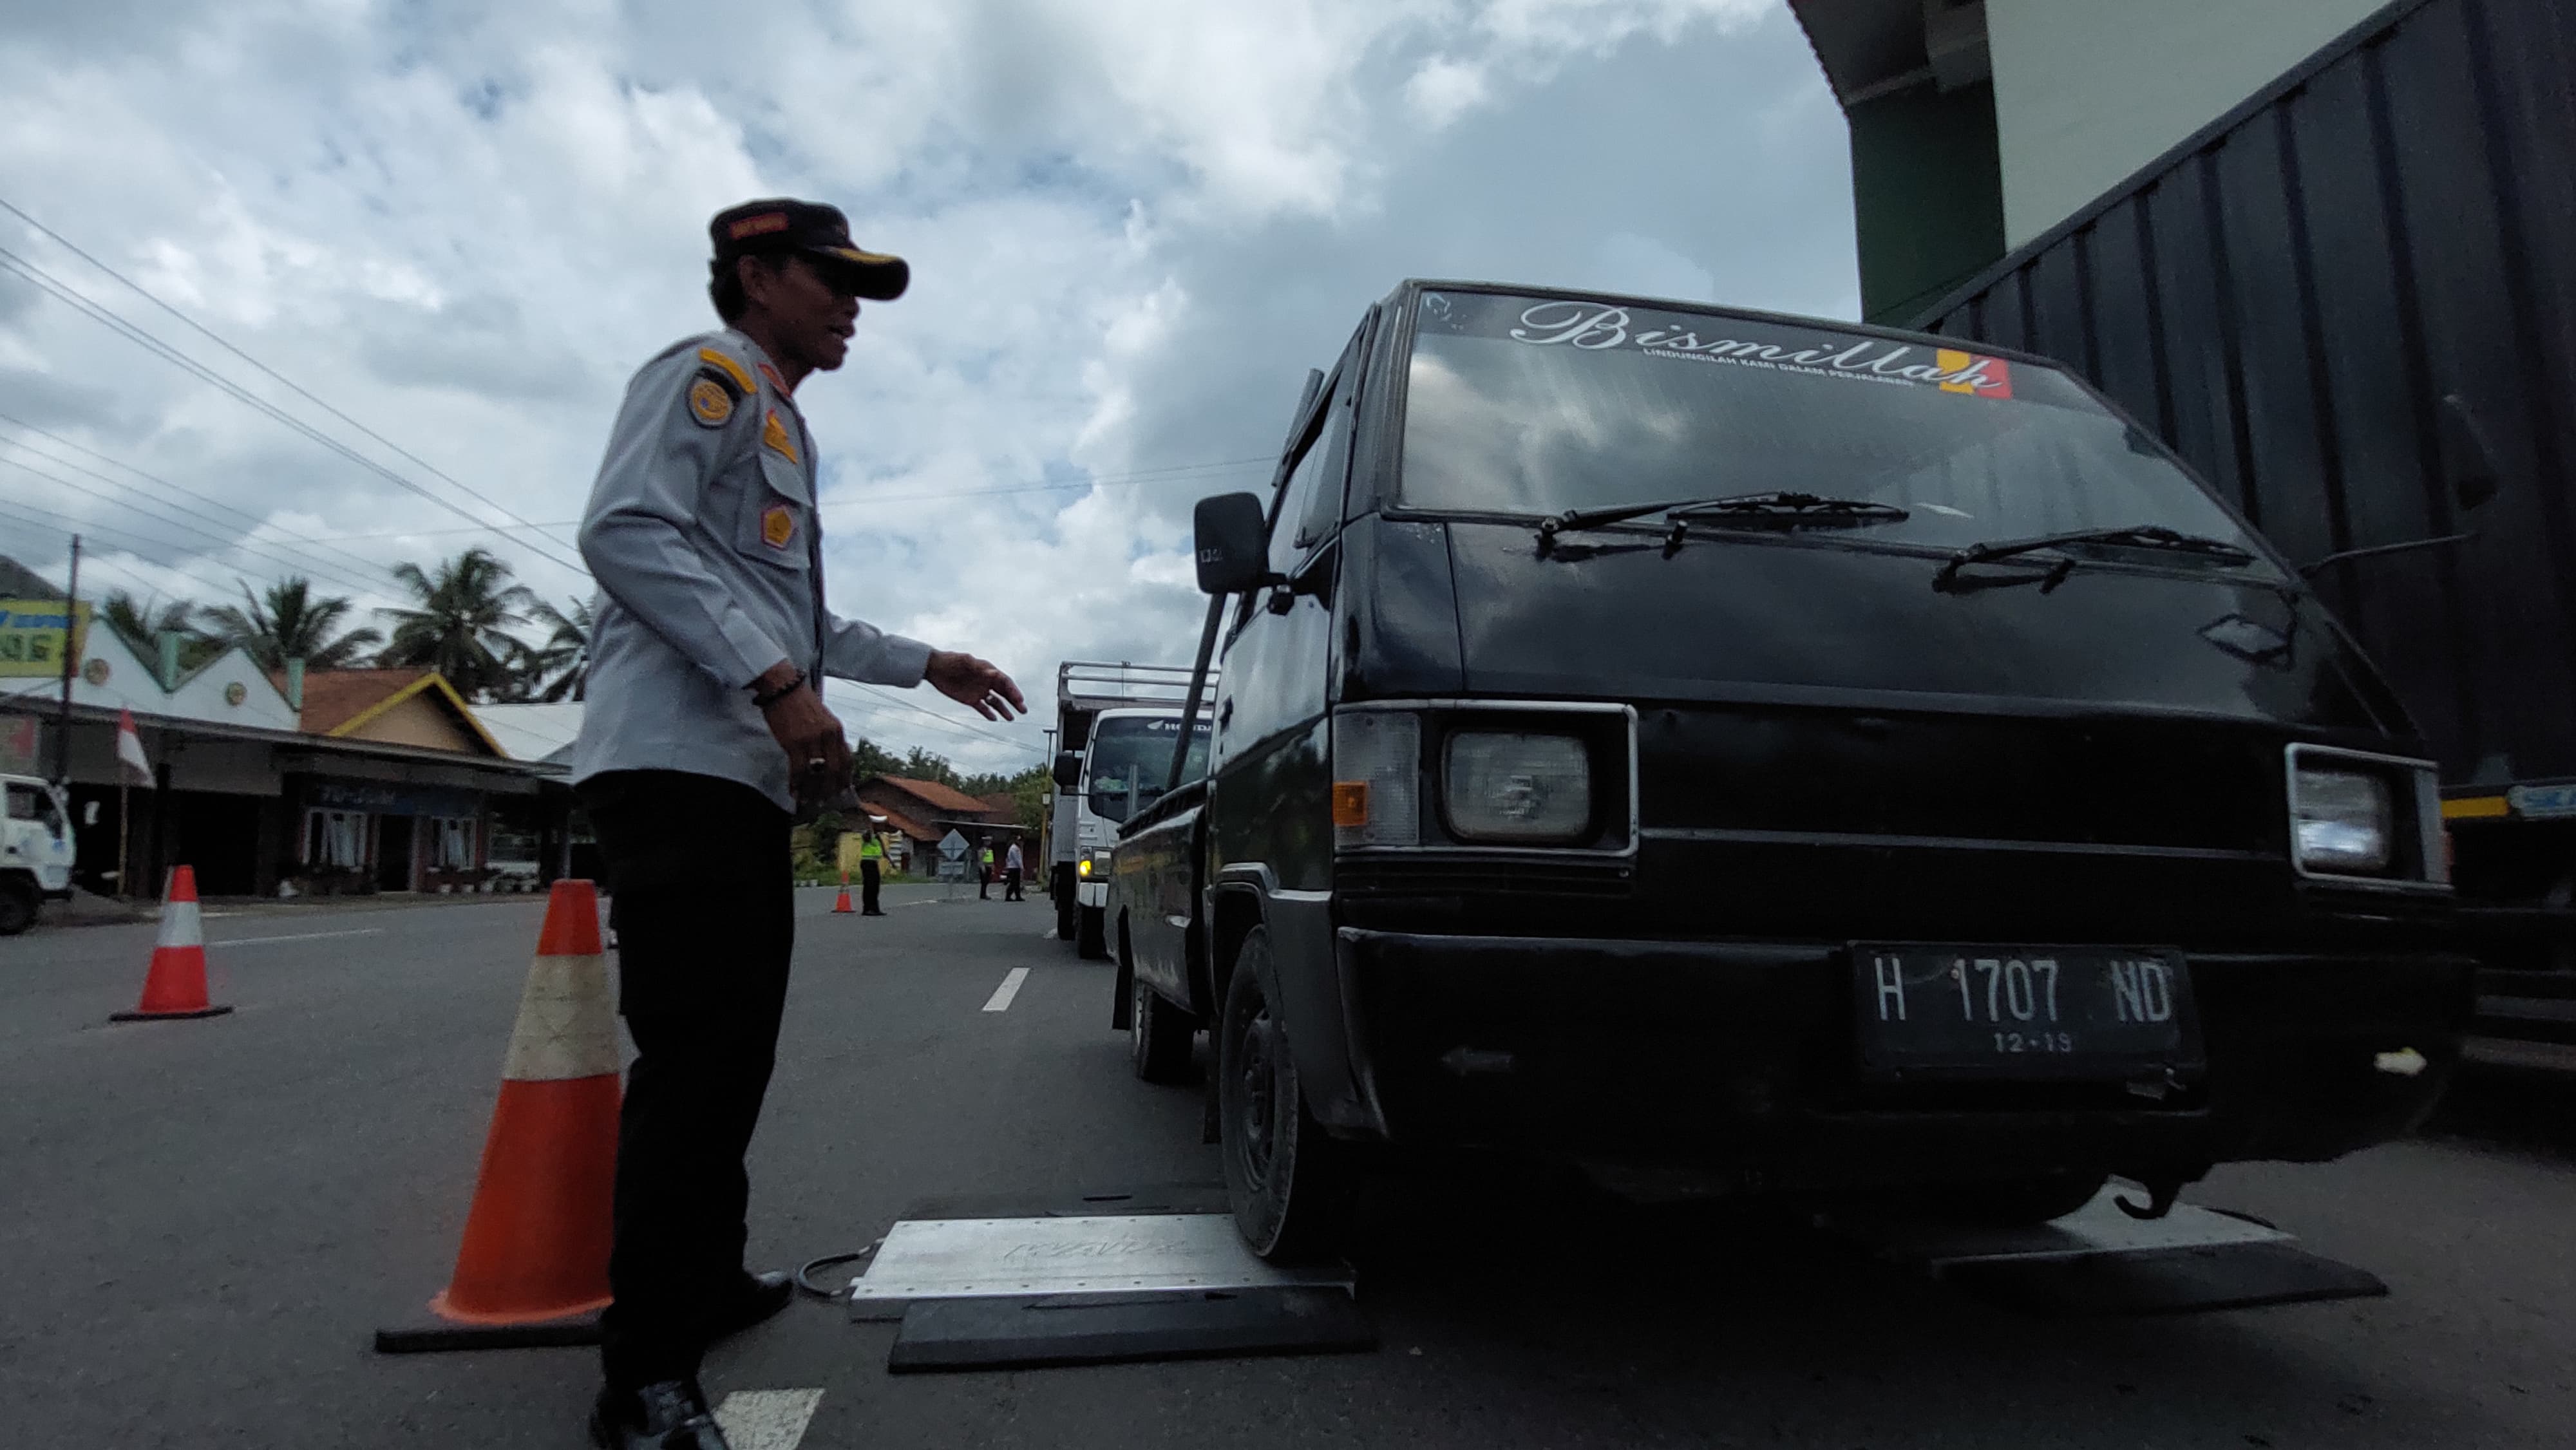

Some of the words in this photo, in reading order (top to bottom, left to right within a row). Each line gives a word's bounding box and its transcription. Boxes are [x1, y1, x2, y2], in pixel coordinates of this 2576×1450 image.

[1509, 301, 2003, 388] Bismillah
[1643, 348, 1737, 366] LINDUNGILAH
[1740, 359, 1776, 370] KAMI
[1874, 957, 1906, 1022] H
[1953, 958, 2059, 1022] 1707
[2109, 959, 2172, 1022] ND
